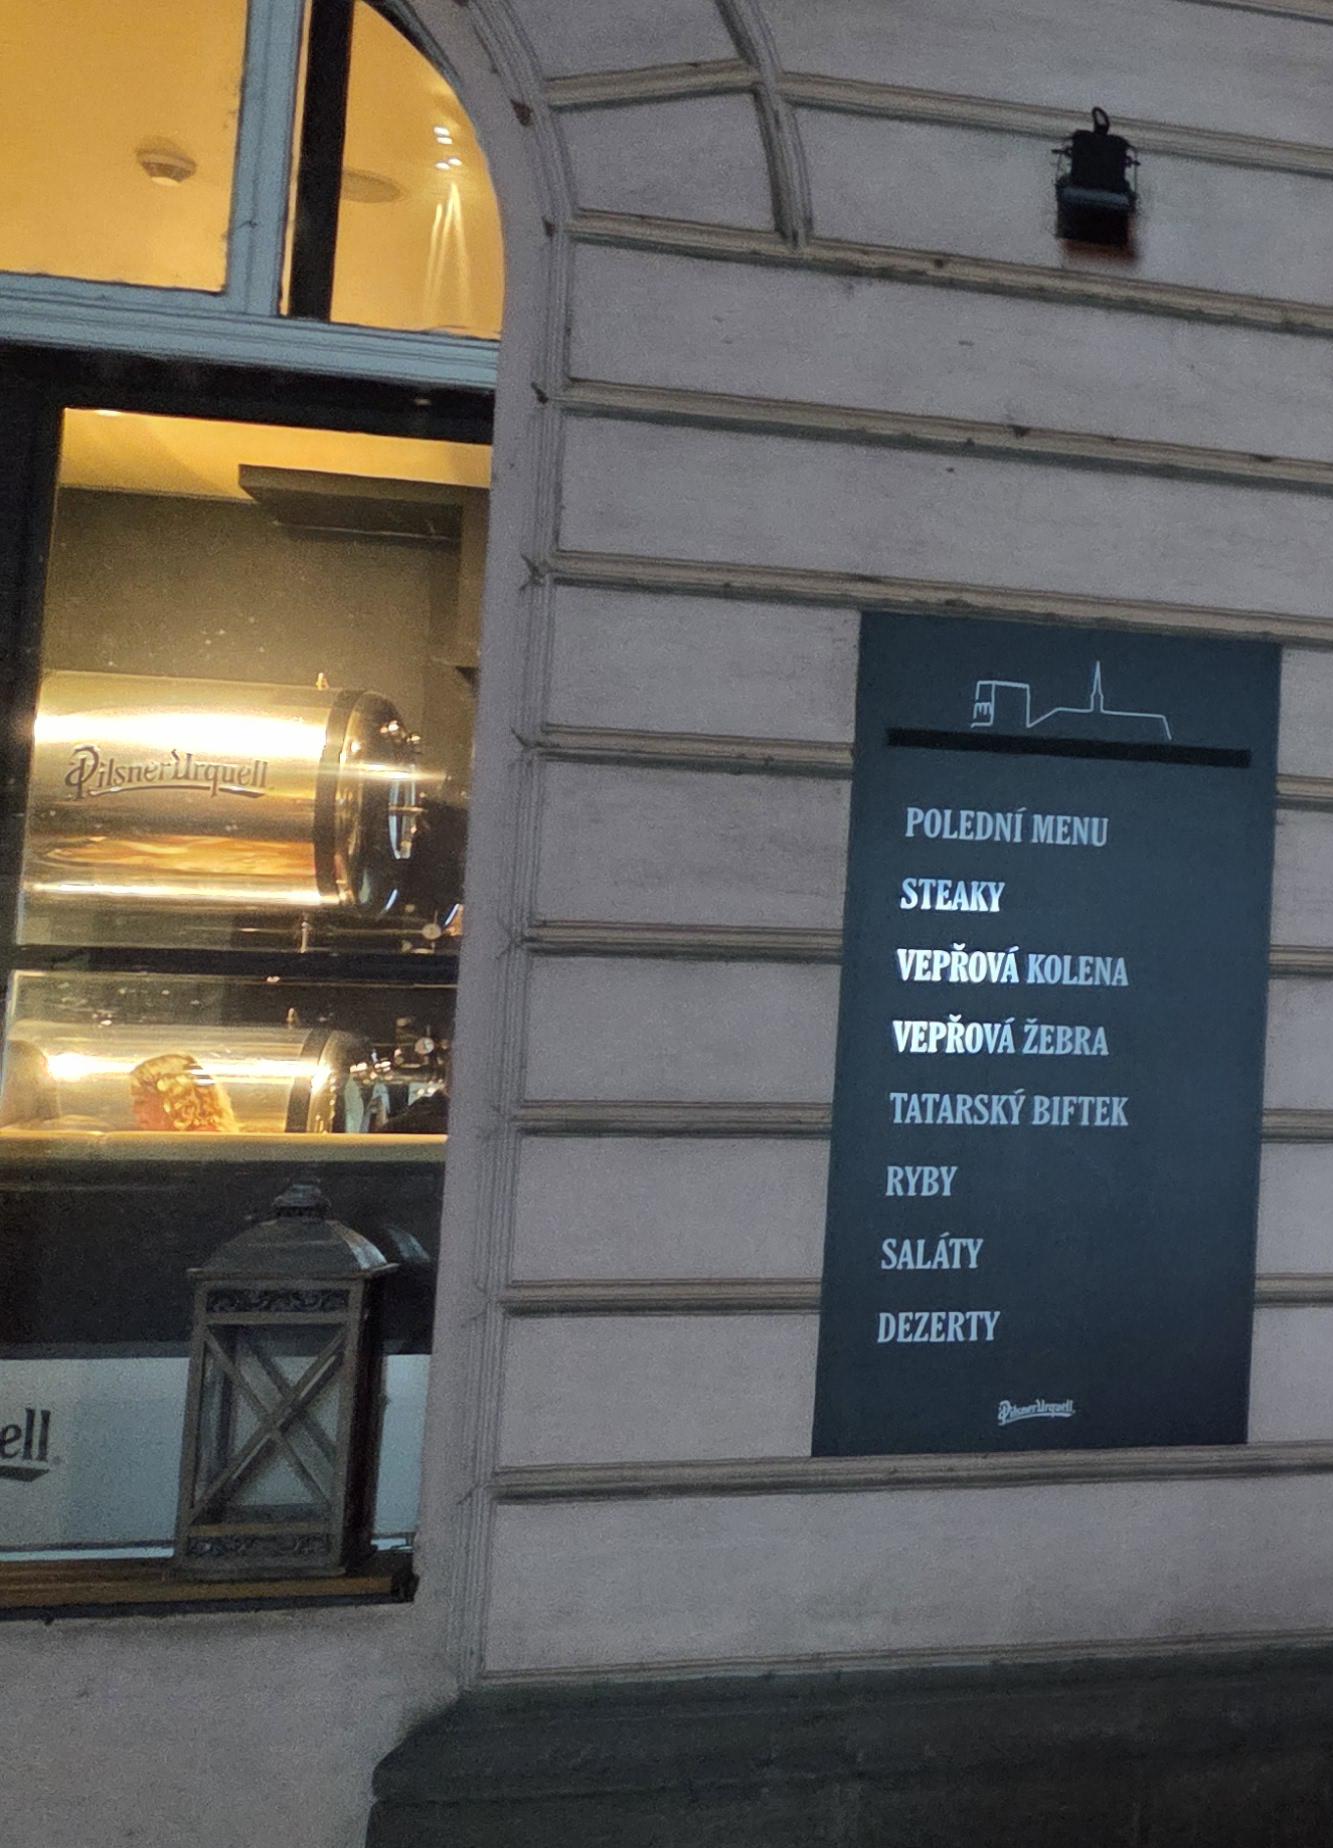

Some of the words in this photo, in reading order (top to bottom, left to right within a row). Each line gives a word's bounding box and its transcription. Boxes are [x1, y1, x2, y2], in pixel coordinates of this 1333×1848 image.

[65, 745, 171, 799] Pilsner
[172, 749, 268, 796] Urquell
[905, 807, 1027, 842] POLEDNÍ
[1032, 814, 1109, 847] MENU
[900, 878, 1005, 913] STEAKY
[896, 943, 1019, 984] VEPŘOVÁ
[1026, 953, 1129, 987] KOLENA
[892, 1015, 1015, 1054] VEPŘOVÁ
[1022, 1018, 1109, 1056] ŽEBRA
[890, 1090, 1025, 1126] TATARSKÝ
[1033, 1096, 1128, 1127] BIFTEK
[885, 1166, 957, 1197] RYBY
[880, 1233, 984, 1270] SALÁTY
[877, 1311, 1000, 1344] DEZERTY
